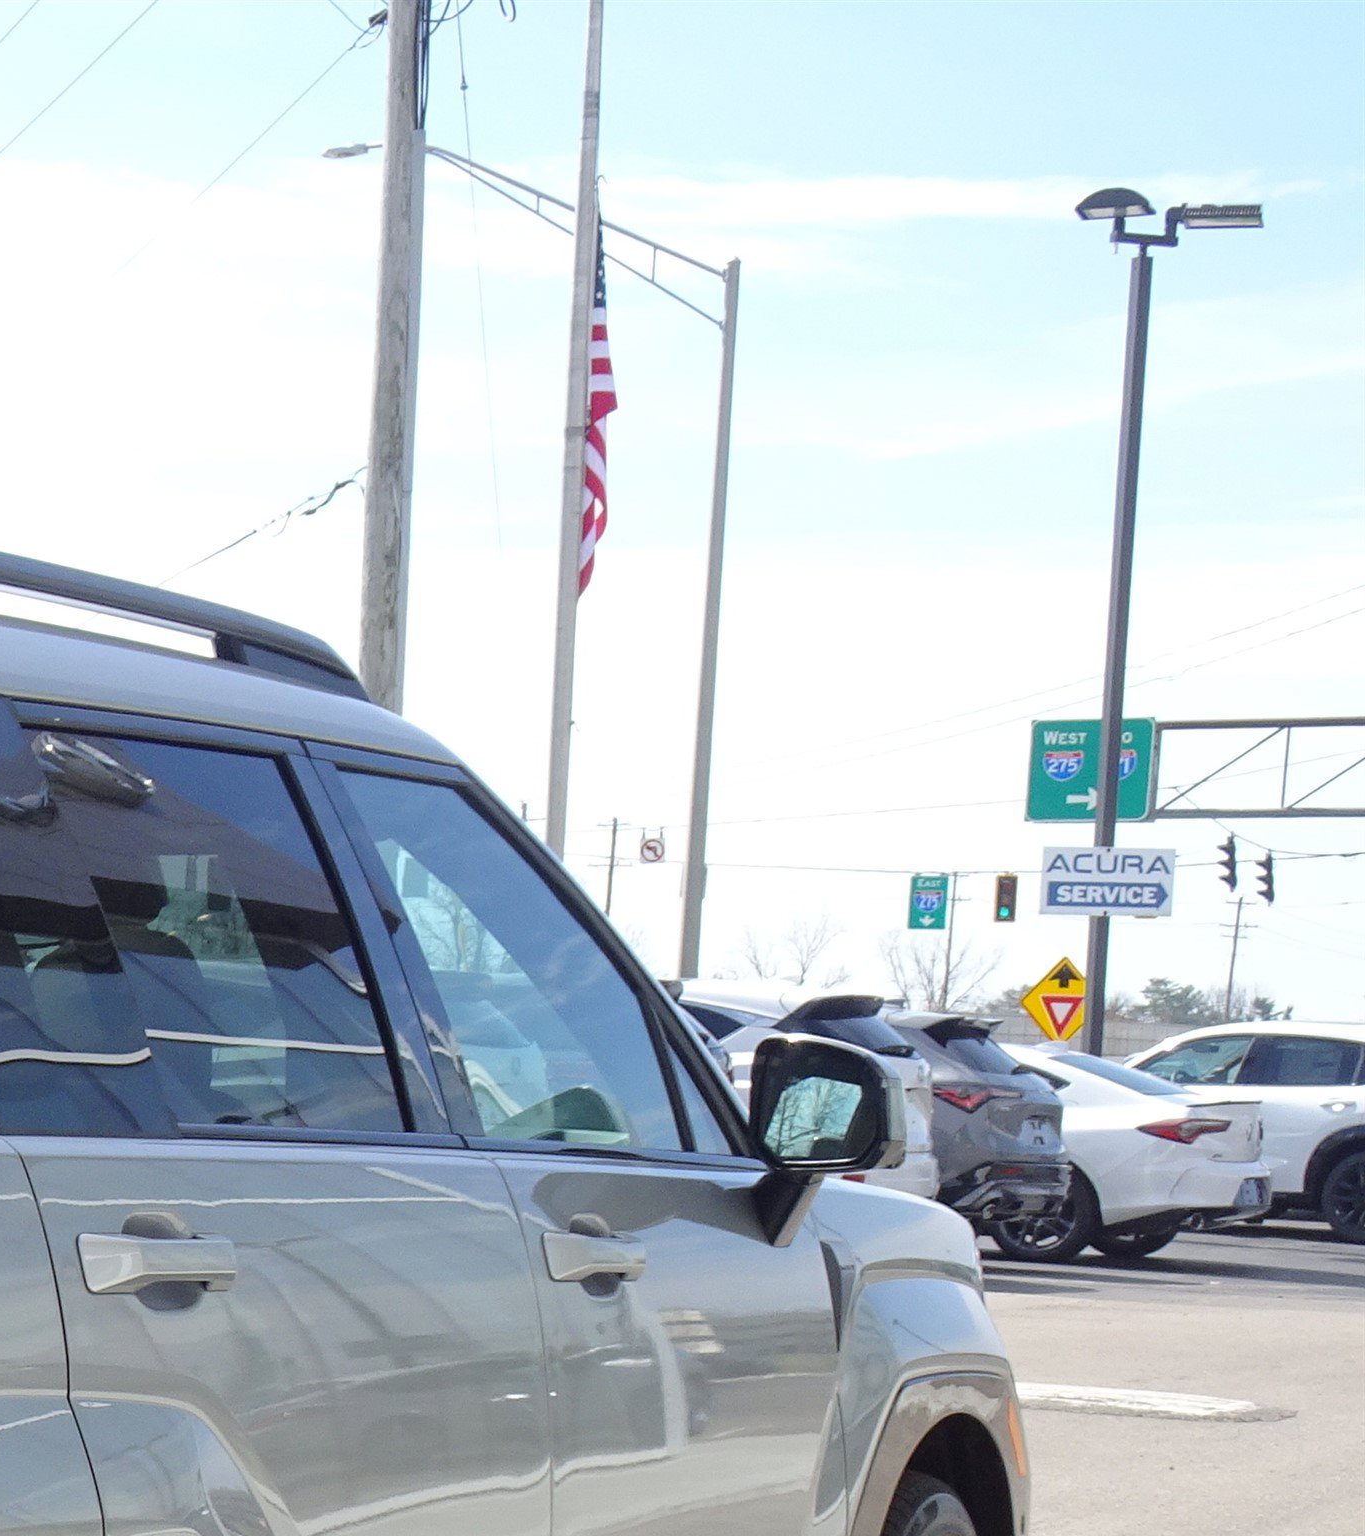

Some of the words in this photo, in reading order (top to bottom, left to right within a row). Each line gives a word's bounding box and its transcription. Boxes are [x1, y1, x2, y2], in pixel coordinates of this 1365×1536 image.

[1044, 731, 1087, 745] WEST
[1121, 731, 1133, 744] O
[1048, 759, 1079, 773] 275
[1047, 854, 1170, 873] ACURA
[1055, 884, 1158, 904] SERVICE
